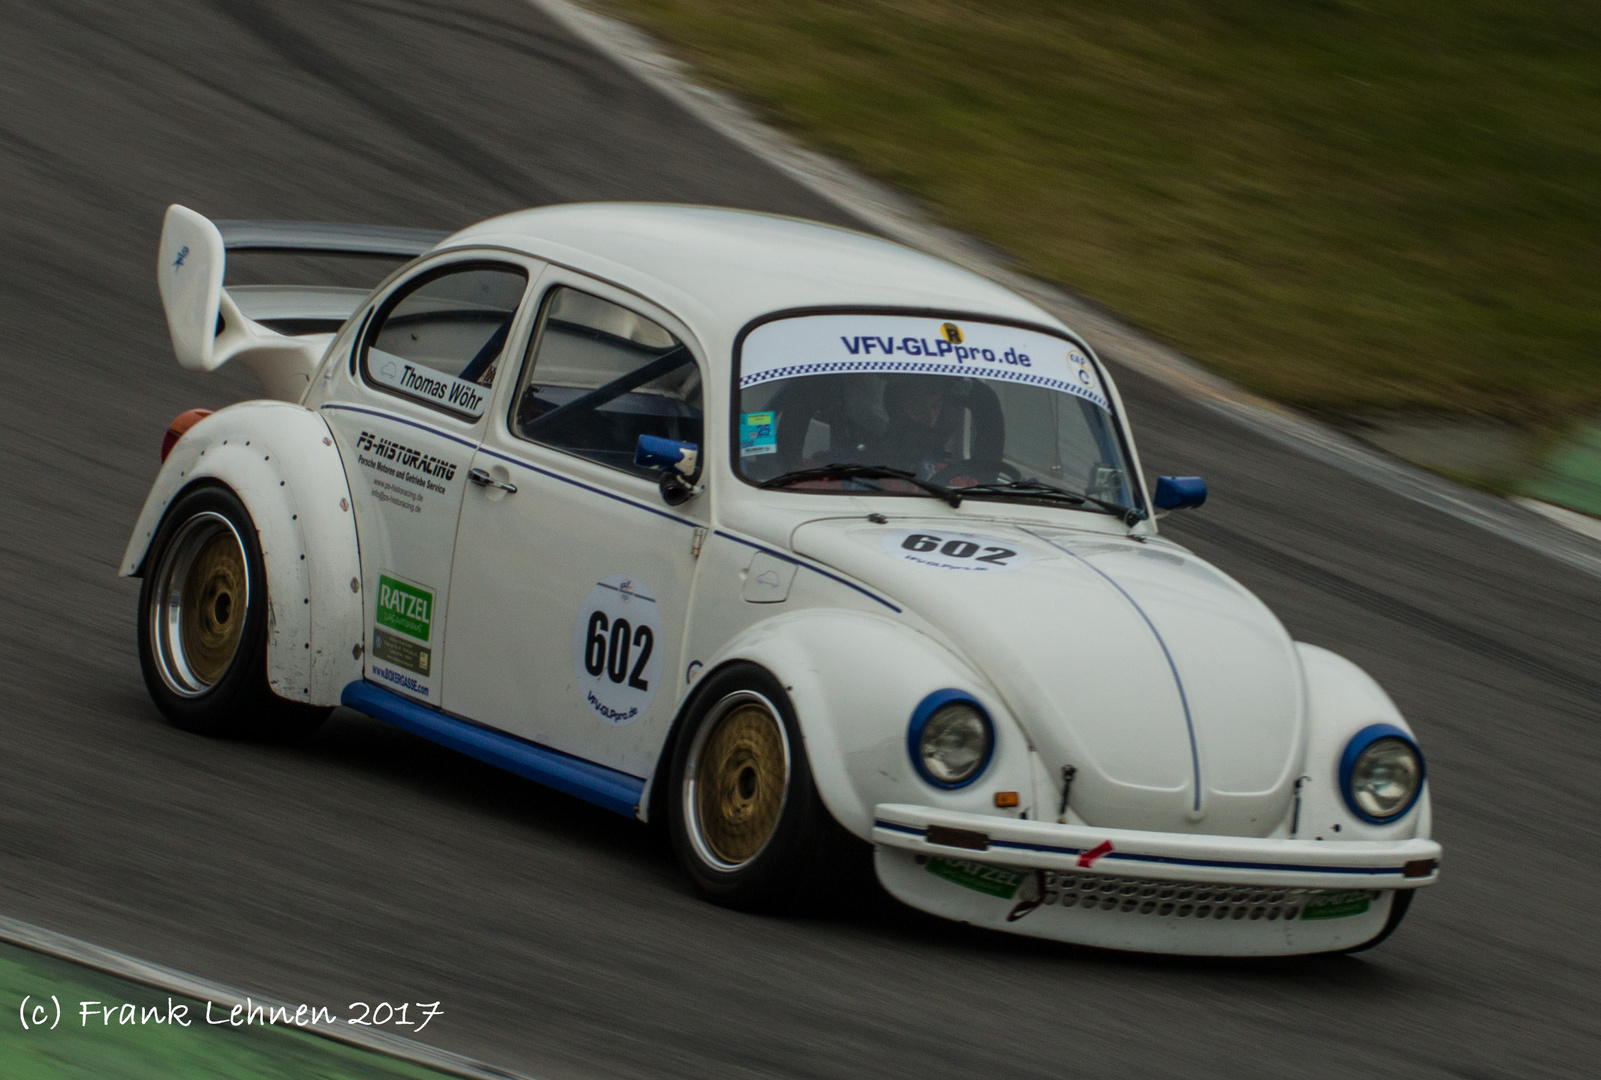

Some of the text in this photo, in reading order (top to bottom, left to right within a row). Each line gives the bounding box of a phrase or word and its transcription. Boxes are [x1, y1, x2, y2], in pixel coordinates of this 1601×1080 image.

[841, 336, 1032, 367] VFV-GLPpro.de
[400, 365, 484, 410] Thomas Wöhr
[356, 430, 458, 481] PS-HISTORACING
[357, 454, 446, 495] Porsche Motoren und Getriebe Service
[901, 533, 1018, 567] 602
[380, 583, 430, 624] RATZEL
[585, 610, 655, 692] 602
